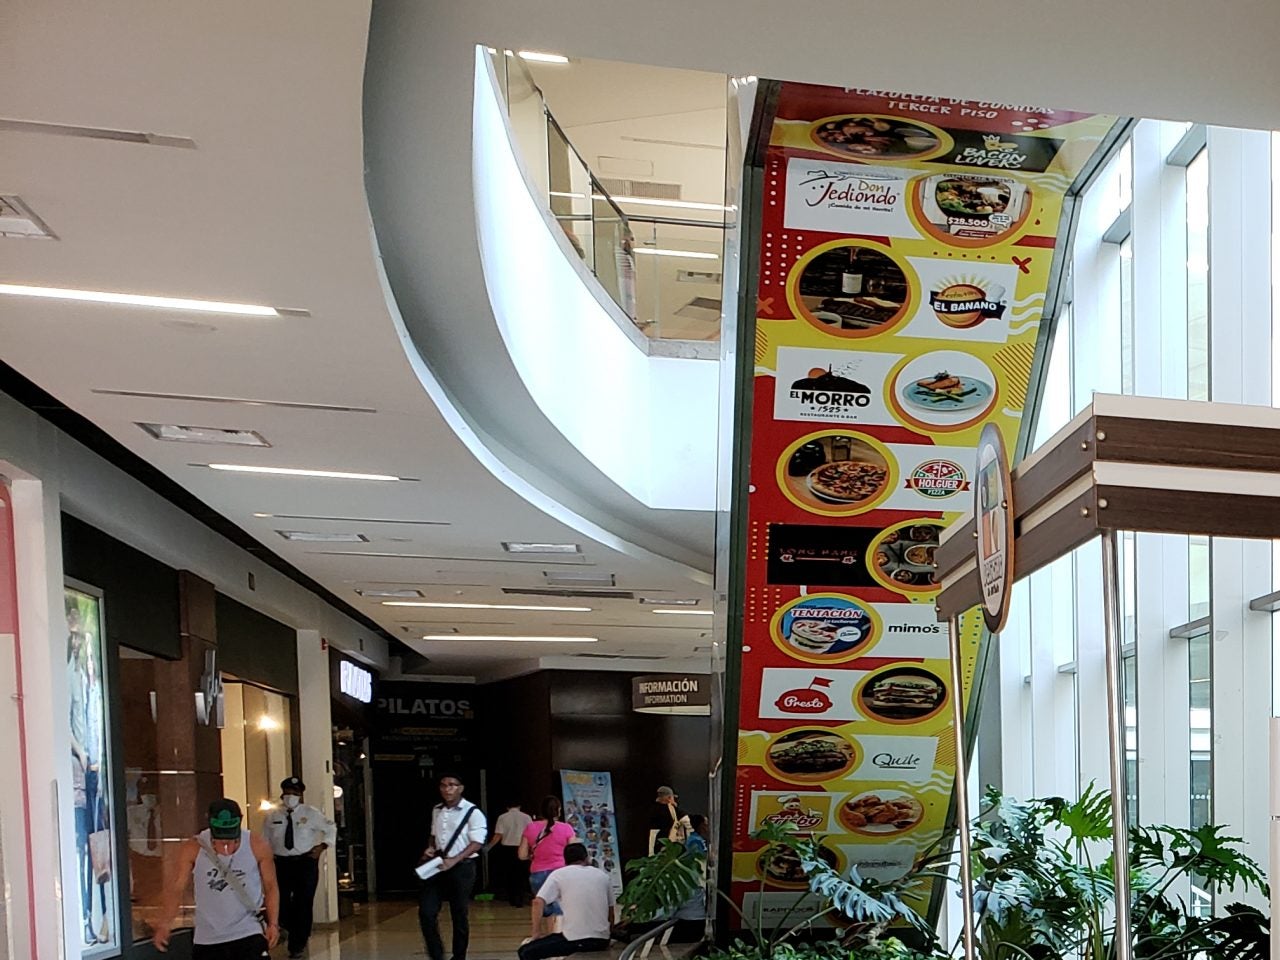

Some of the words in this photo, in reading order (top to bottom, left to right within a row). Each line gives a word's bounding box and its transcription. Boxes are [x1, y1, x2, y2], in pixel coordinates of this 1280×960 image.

[888, 101, 950, 114] TERCER
[960, 107, 999, 119] PISO
[963, 147, 1027, 162] BACON
[858, 179, 885, 193] Don
[805, 181, 897, 208] Jediondo
[934, 301, 948, 311] EL
[950, 301, 997, 312] BANANO
[801, 391, 870, 407] MORRO
[918, 478, 959, 489] HOLGUER
[791, 608, 864, 619] TENTACIÓN
[639, 678, 698, 694] INFORMACIÓN
[783, 697, 824, 709] Presto
